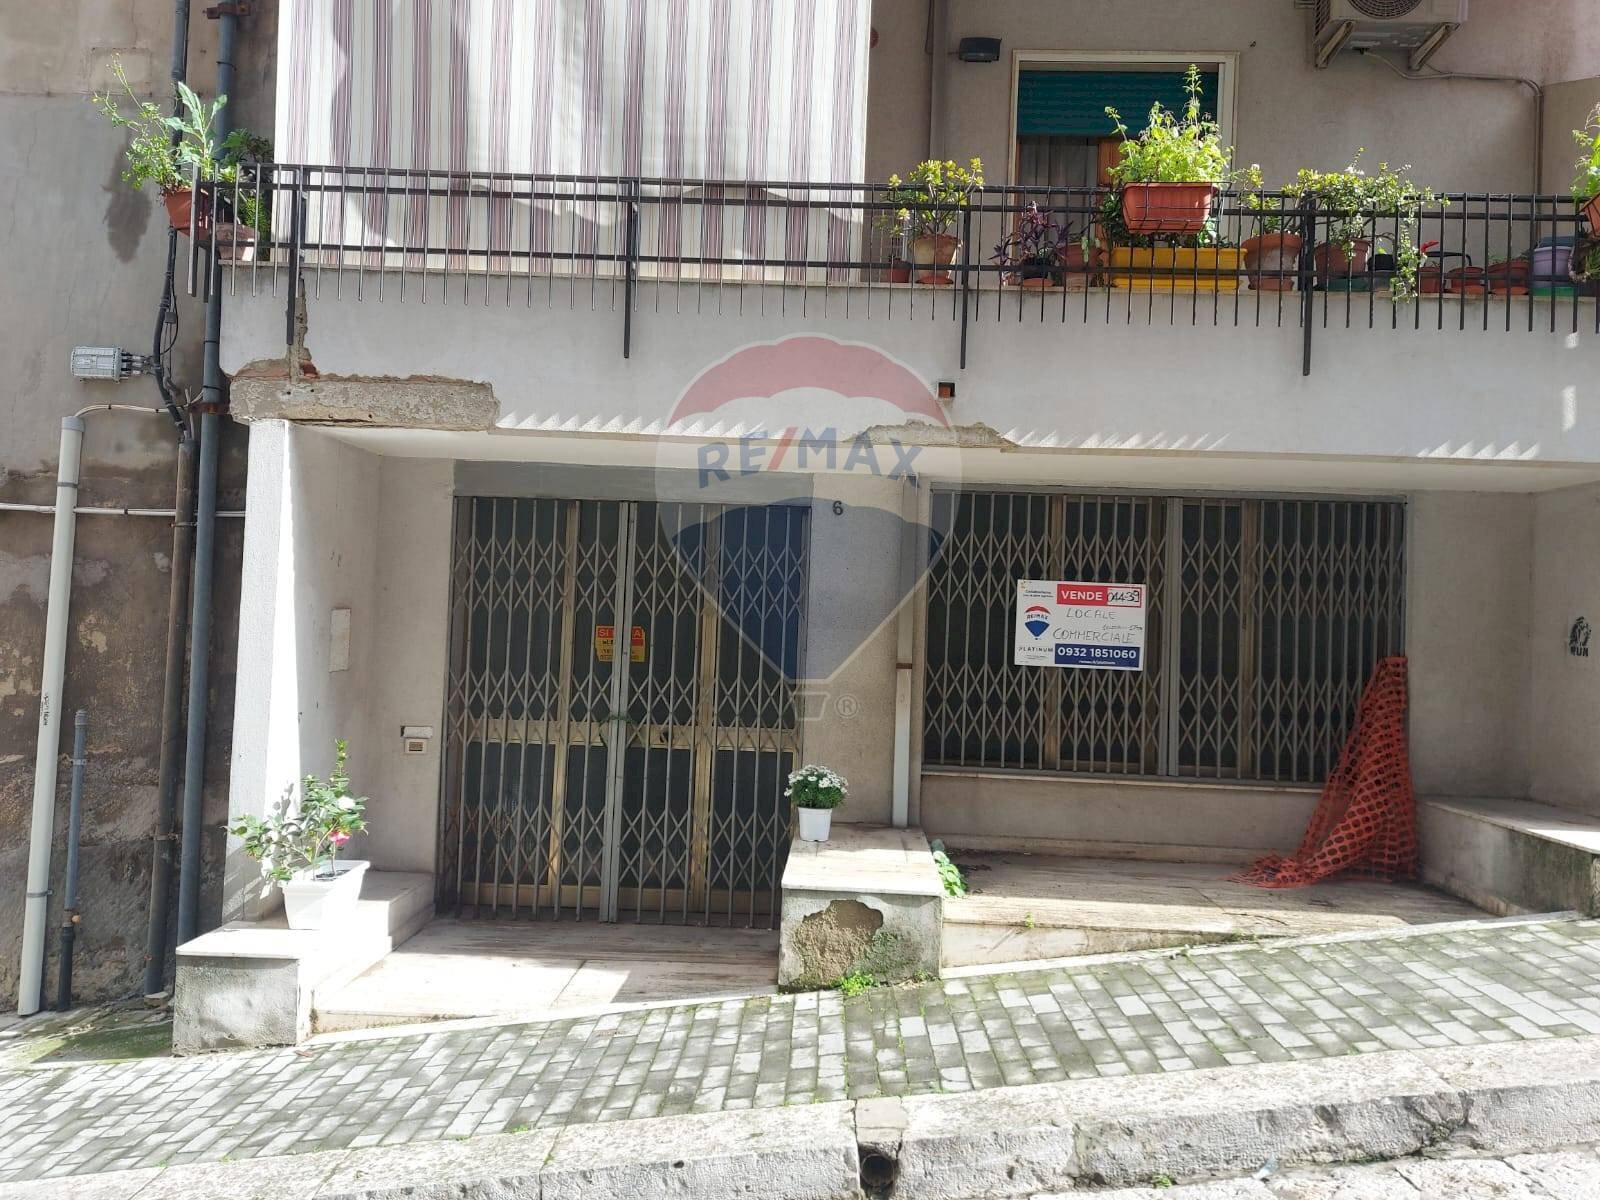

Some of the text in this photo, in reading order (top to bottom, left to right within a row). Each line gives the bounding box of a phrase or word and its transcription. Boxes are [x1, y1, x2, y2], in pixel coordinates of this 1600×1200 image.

[832, 500, 844, 516] 6
[1061, 590, 1103, 601] VENDE
[1066, 607, 1116, 620] LOCALE
[1053, 627, 1136, 644] COMMERCIALE
[1057, 647, 1087, 657] 0932
[1090, 647, 1137, 659] 1851060
